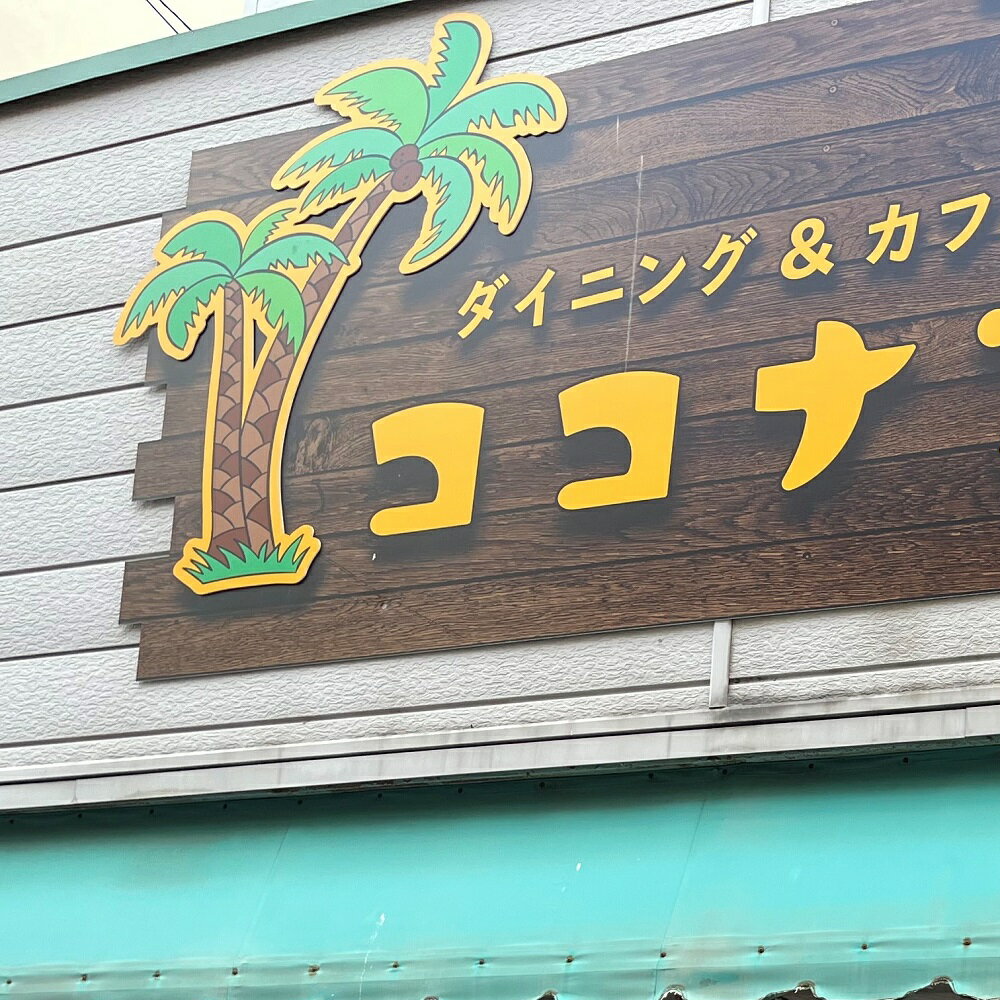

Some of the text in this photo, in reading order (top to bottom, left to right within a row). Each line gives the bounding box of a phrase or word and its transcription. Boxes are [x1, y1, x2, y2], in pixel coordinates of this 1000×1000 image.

[457, 226, 758, 340] ダイニング
[780, 217, 835, 280] &
